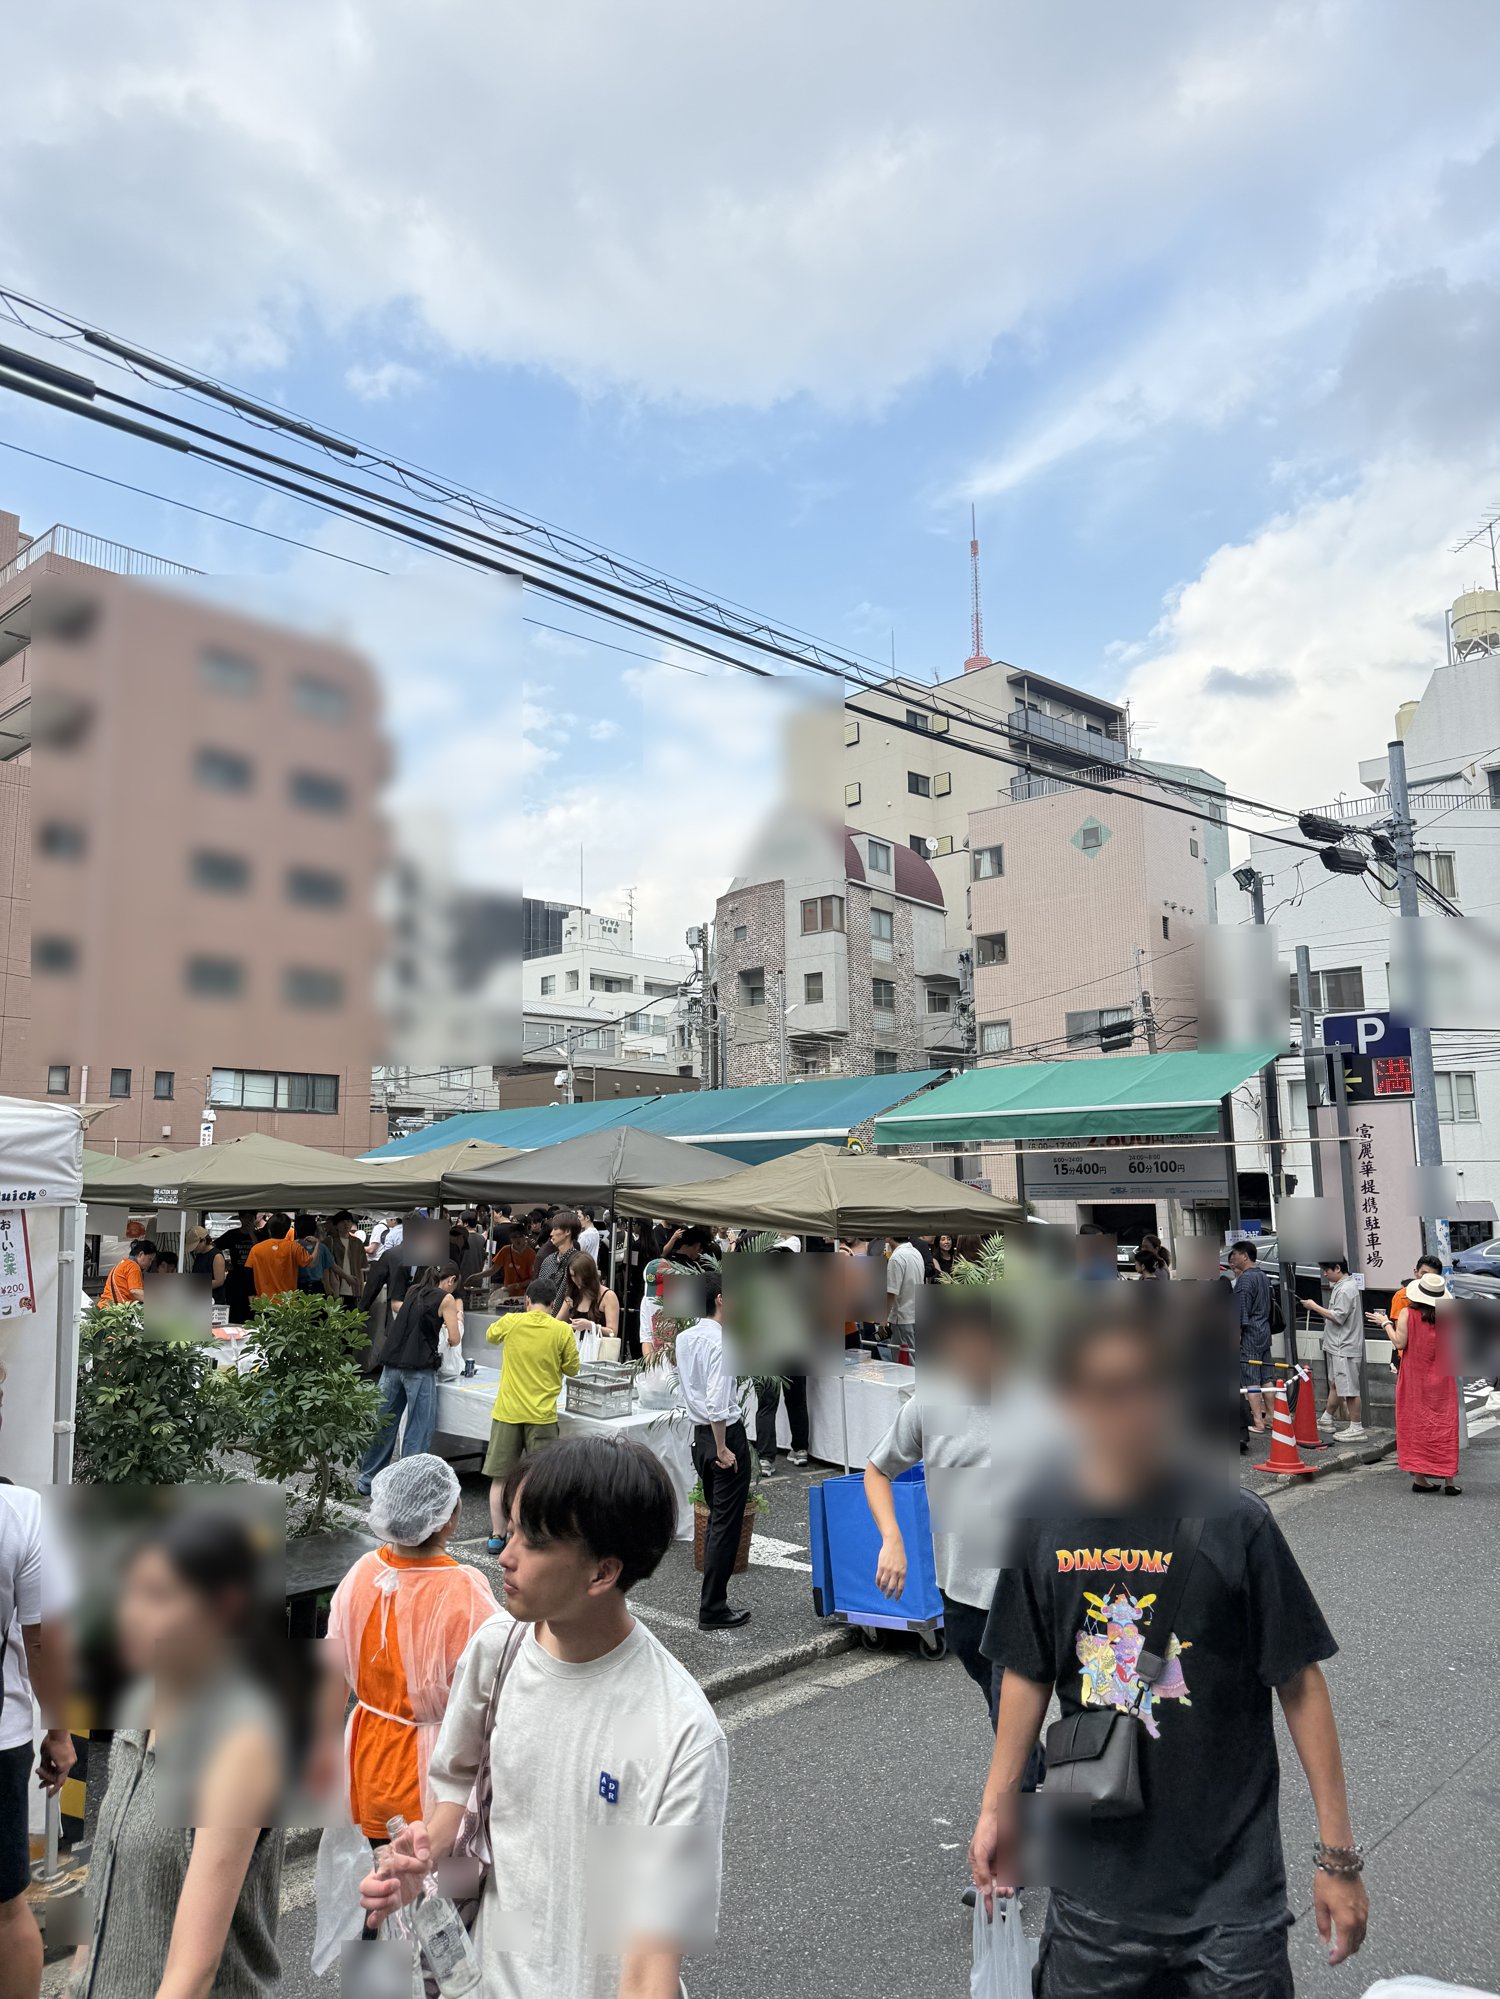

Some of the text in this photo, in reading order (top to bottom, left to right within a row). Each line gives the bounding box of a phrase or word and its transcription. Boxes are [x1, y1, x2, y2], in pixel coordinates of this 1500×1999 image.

[1357, 1017, 1385, 1054] P
[1376, 1060, 1410, 1094] 満
[1053, 1163, 1107, 1175] 15分400円
[1128, 1160, 1185, 1174] 60分100円
[0, 1190, 37, 1202] uick
[1355, 1123, 1384, 1268] 富麗華提携駐車場
[0, 1219, 17, 1276] おーいお茶
[0, 1283, 25, 1295] ¥200
